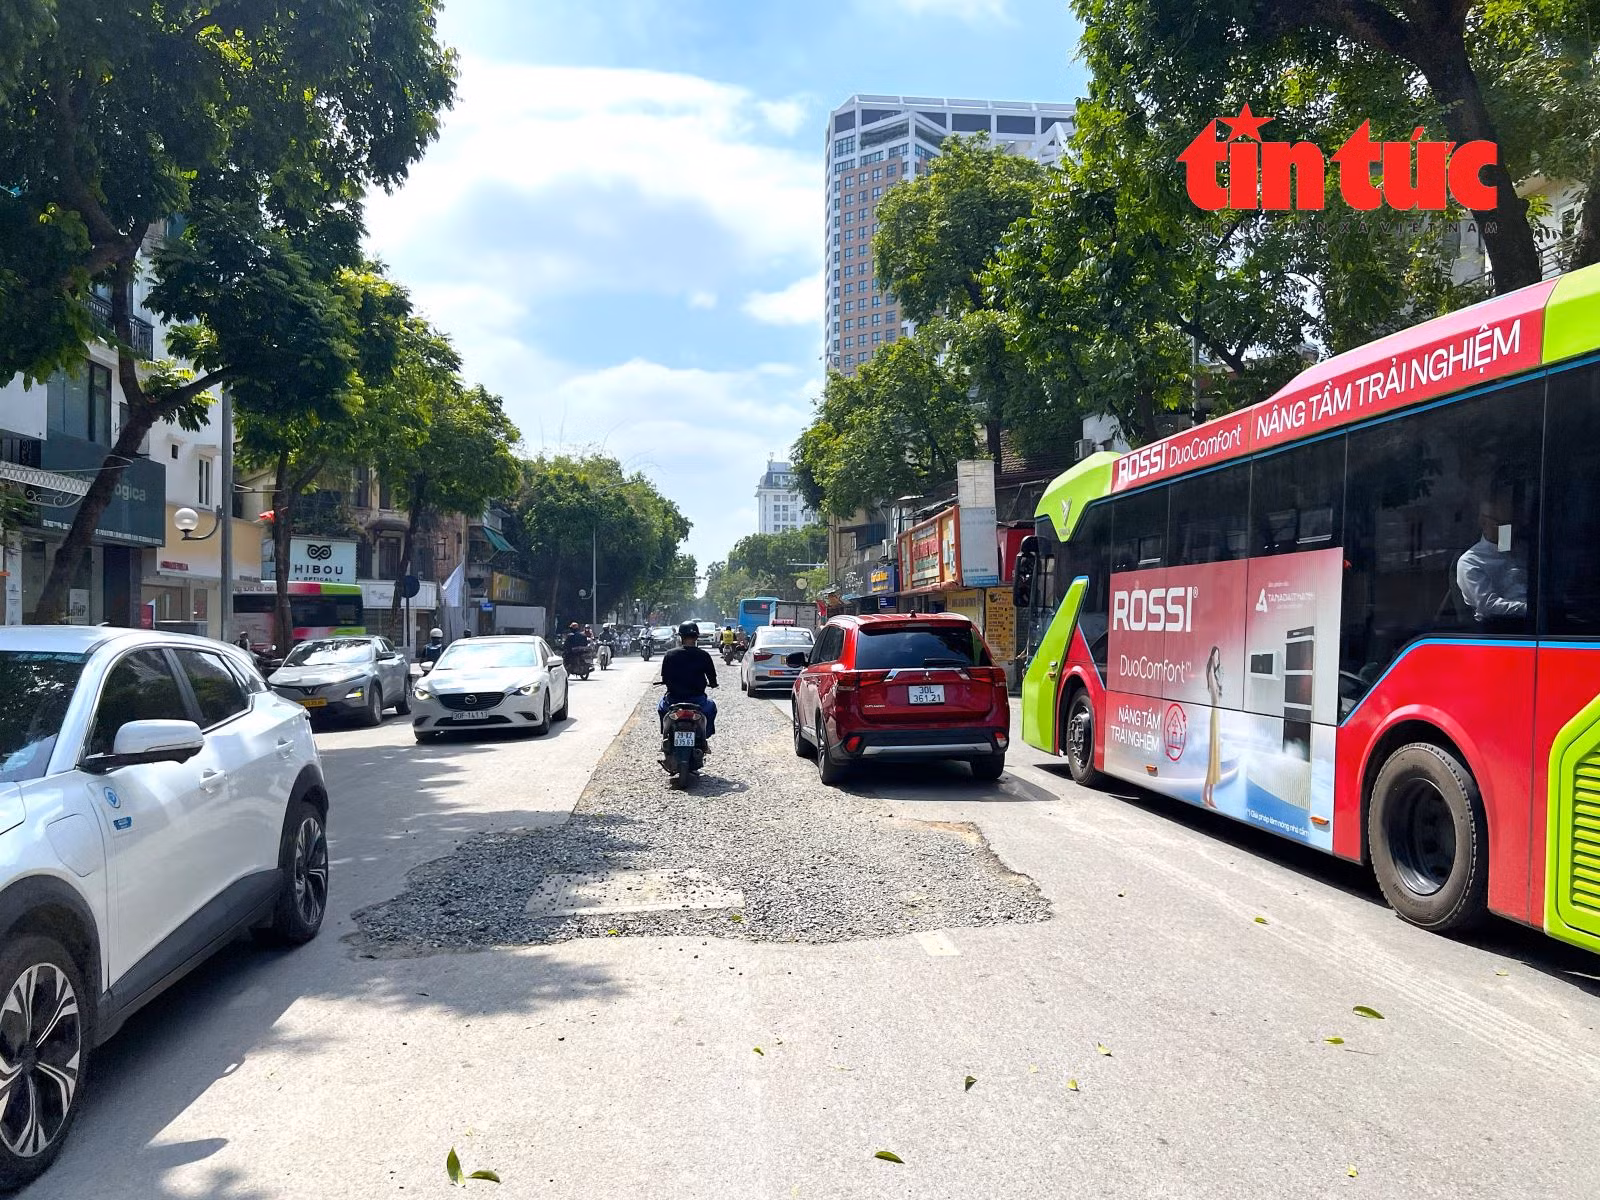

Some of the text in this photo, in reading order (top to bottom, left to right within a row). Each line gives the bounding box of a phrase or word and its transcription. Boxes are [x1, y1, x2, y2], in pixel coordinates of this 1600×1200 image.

[1256, 318, 1521, 441] NÂNG TẦM TRẢI NGHIỆM
[1117, 423, 1242, 485] ROSSI DuoComfort
[294, 564, 344, 575] HIBOU
[913, 694, 941, 702] 361.21
[919, 686, 934, 694] 30L
[1118, 704, 1141, 726] NÂNG
[1128, 730, 1160, 755] NGHIỆM
